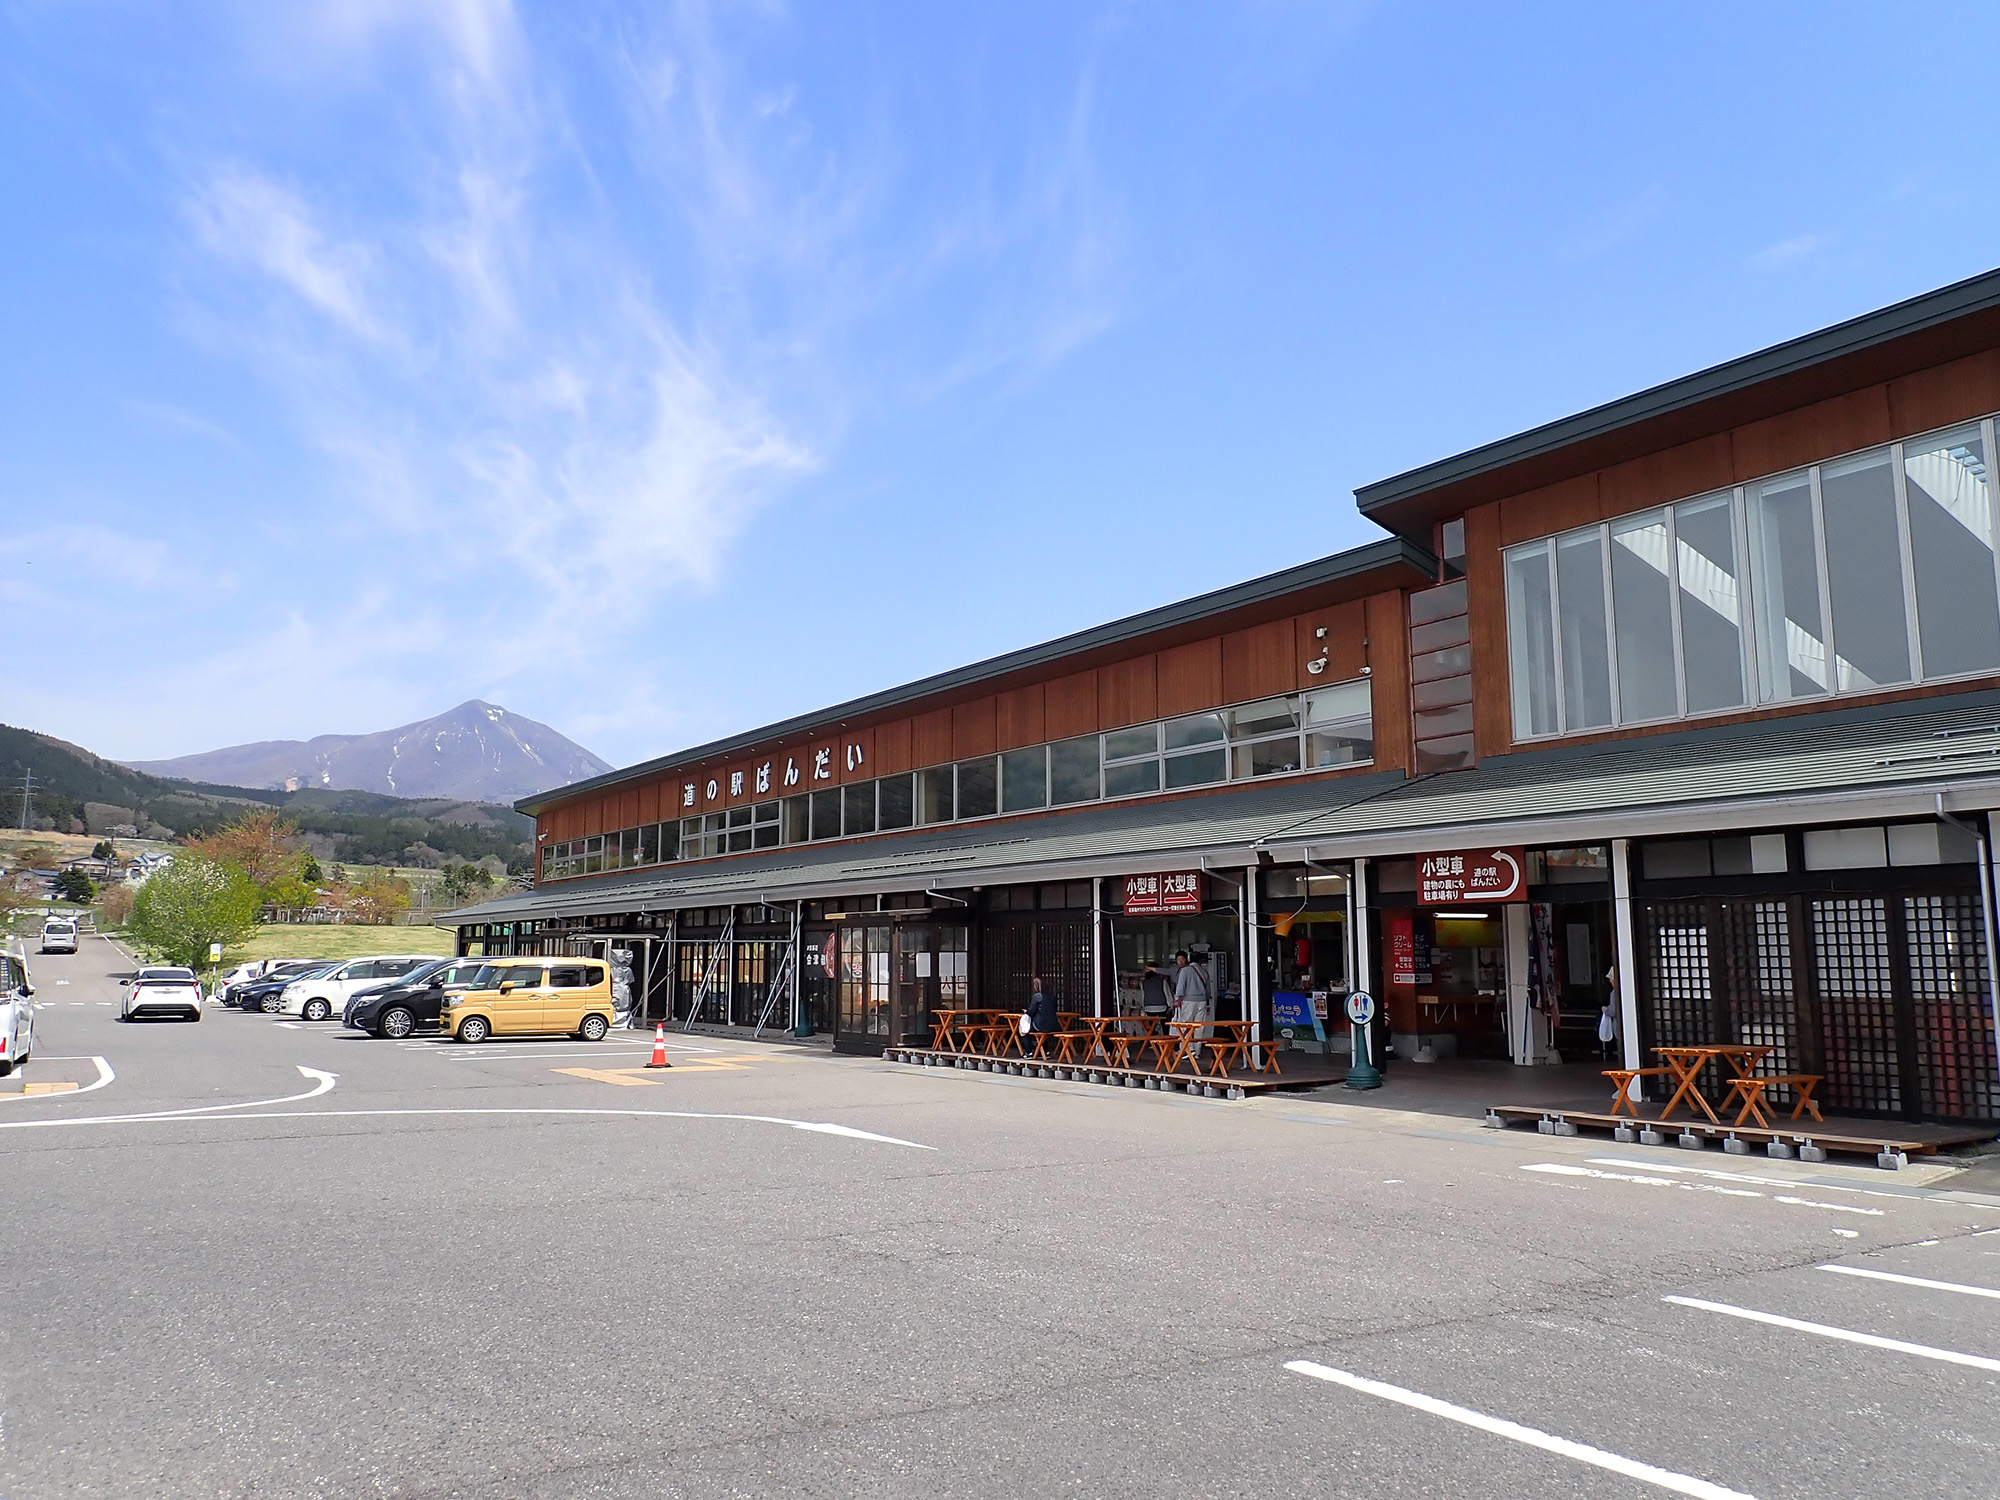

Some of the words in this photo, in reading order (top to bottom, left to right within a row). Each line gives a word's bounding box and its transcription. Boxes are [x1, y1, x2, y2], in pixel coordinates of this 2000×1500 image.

[683, 744, 864, 807] 道の駅ばんだい
[1421, 855, 1465, 877] 小型車
[1473, 867, 1497, 877] 道の駅
[1127, 876, 1158, 895] 小型車
[1164, 873, 1197, 894] 大型車
[1423, 879, 1465, 890] 建物の裏にも
[1470, 877, 1501, 887] ばんだい
[1423, 890, 1459, 901] 駐車場有り
